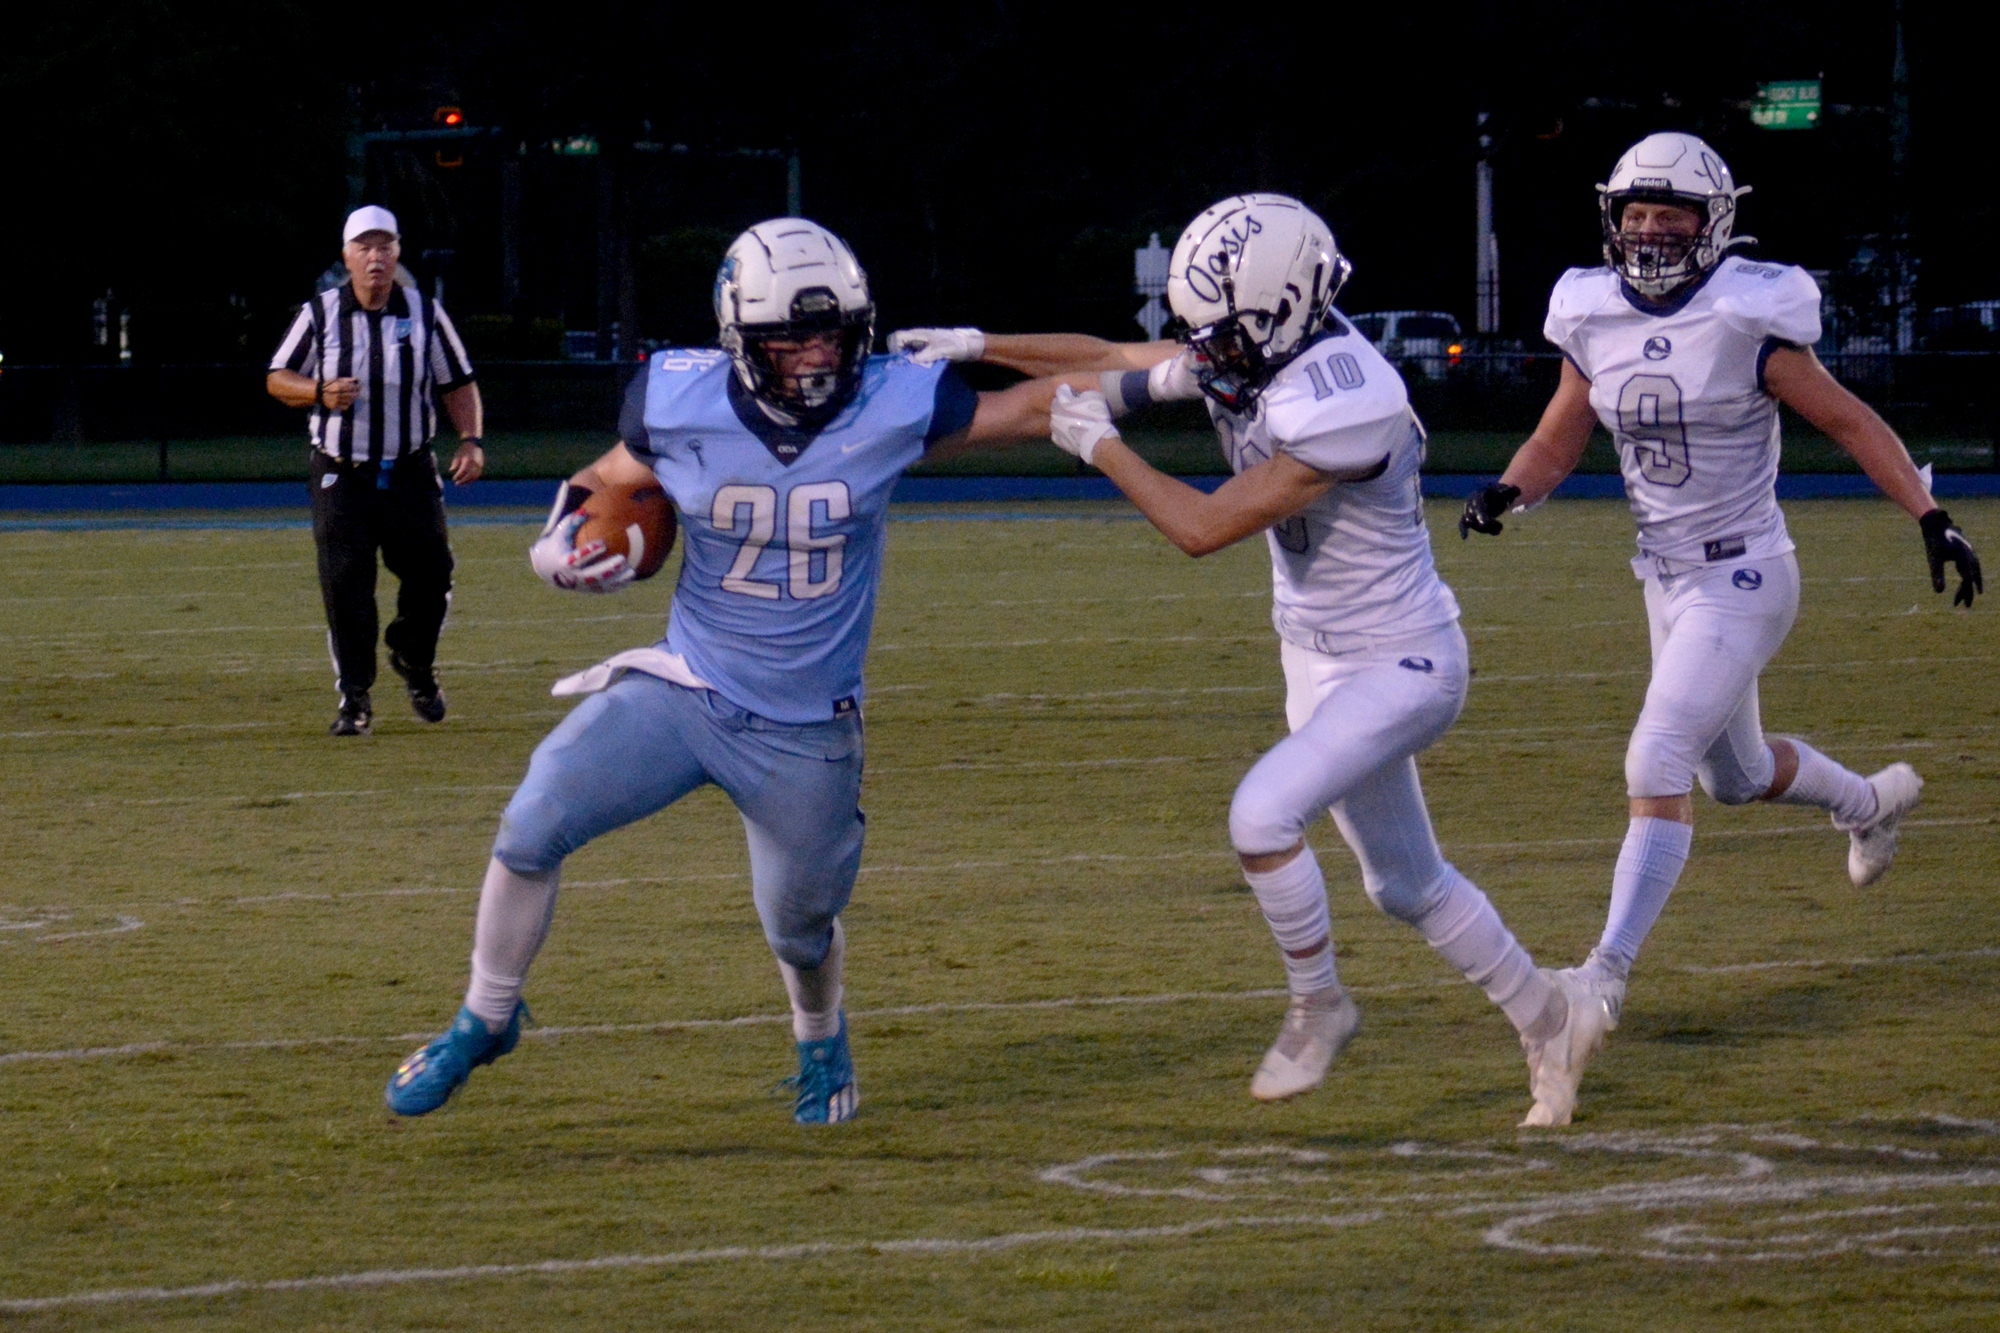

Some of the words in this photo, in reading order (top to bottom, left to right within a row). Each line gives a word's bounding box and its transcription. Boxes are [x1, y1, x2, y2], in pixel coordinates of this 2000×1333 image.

[1634, 178, 1668, 187] Riddell
[1186, 214, 1262, 303] Oasis
[1303, 352, 1365, 401] 10
[1617, 373, 1691, 488] 9
[711, 479, 851, 600] 26
